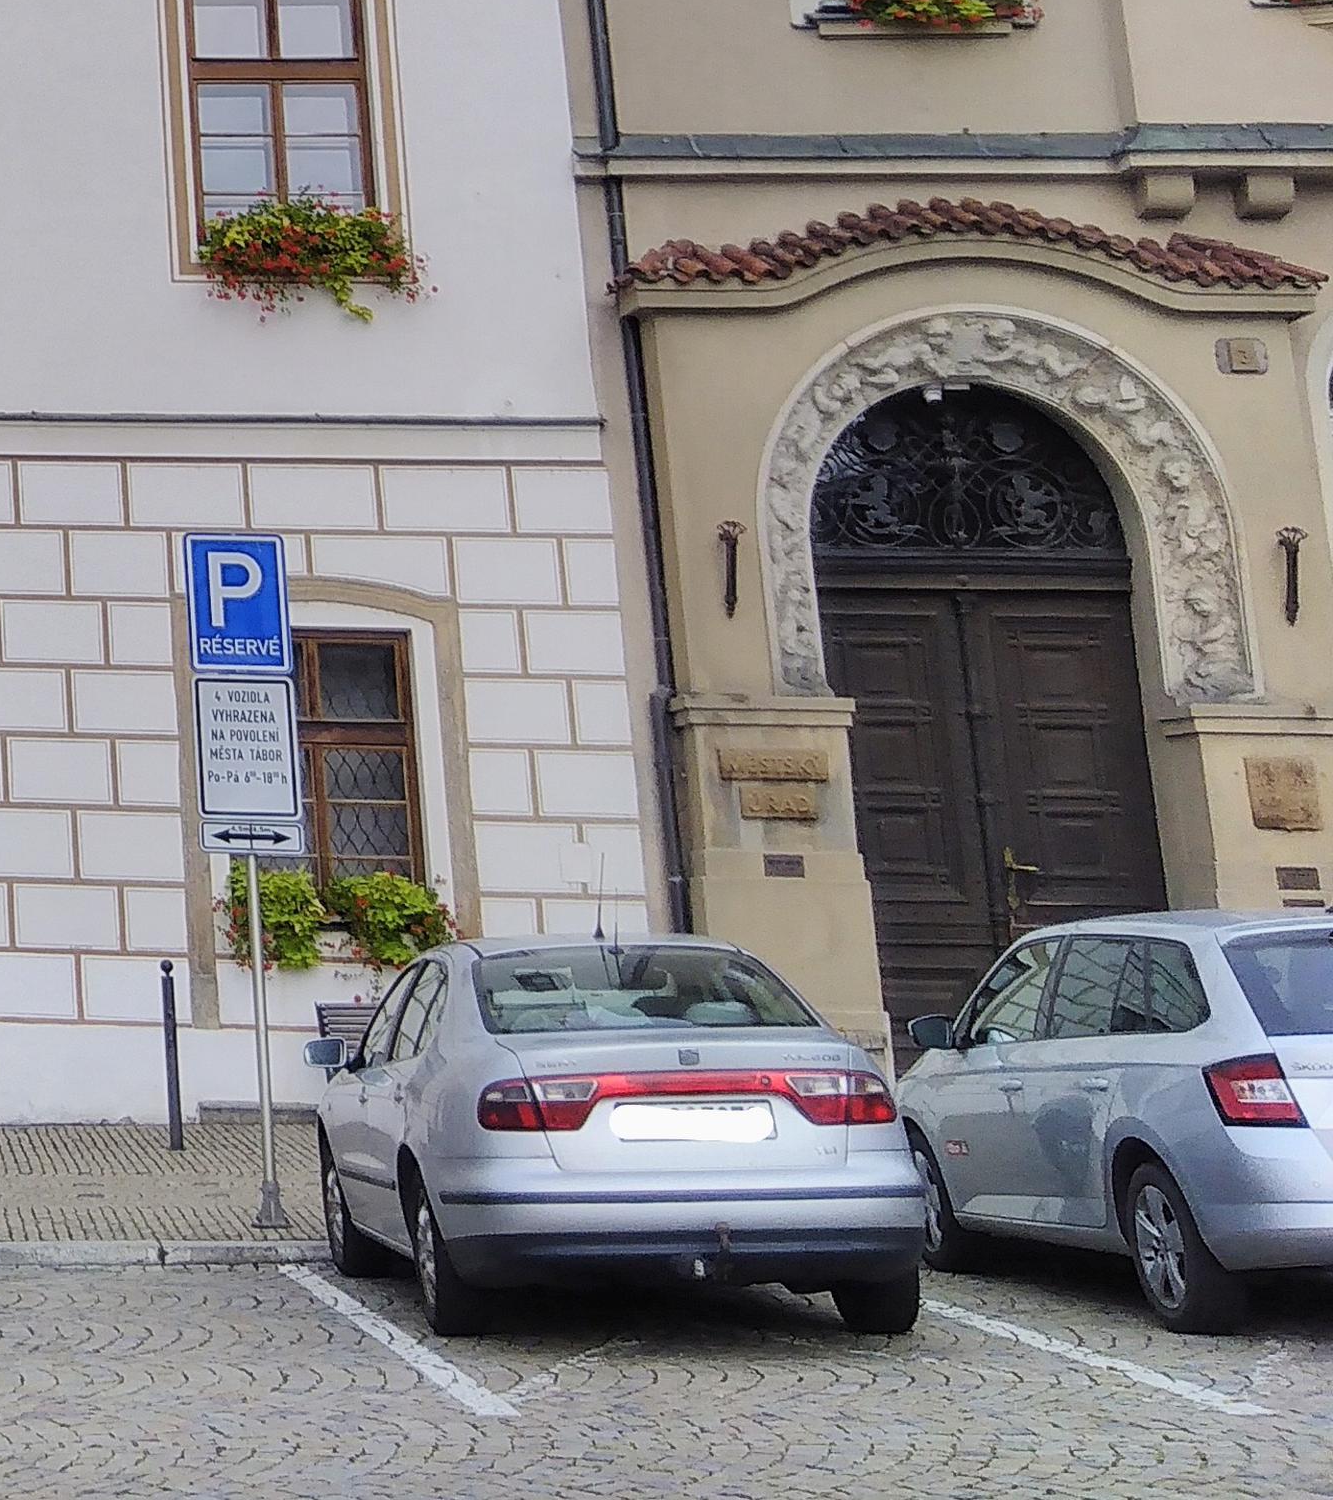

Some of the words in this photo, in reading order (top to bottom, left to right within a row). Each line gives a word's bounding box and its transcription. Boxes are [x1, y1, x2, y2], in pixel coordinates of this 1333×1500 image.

[207, 551, 263, 627] P
[199, 633, 281, 656] RÉSERVÉ
[215, 691, 221, 702] 4
[227, 690, 270, 704] VOZIDLA
[211, 709, 276, 724] VYHRAZENA
[211, 729, 225, 741] NA
[230, 727, 280, 743] POVOLENÍ
[209, 745, 244, 761] MĚSTA
[250, 747, 283, 762] TÁBOR
